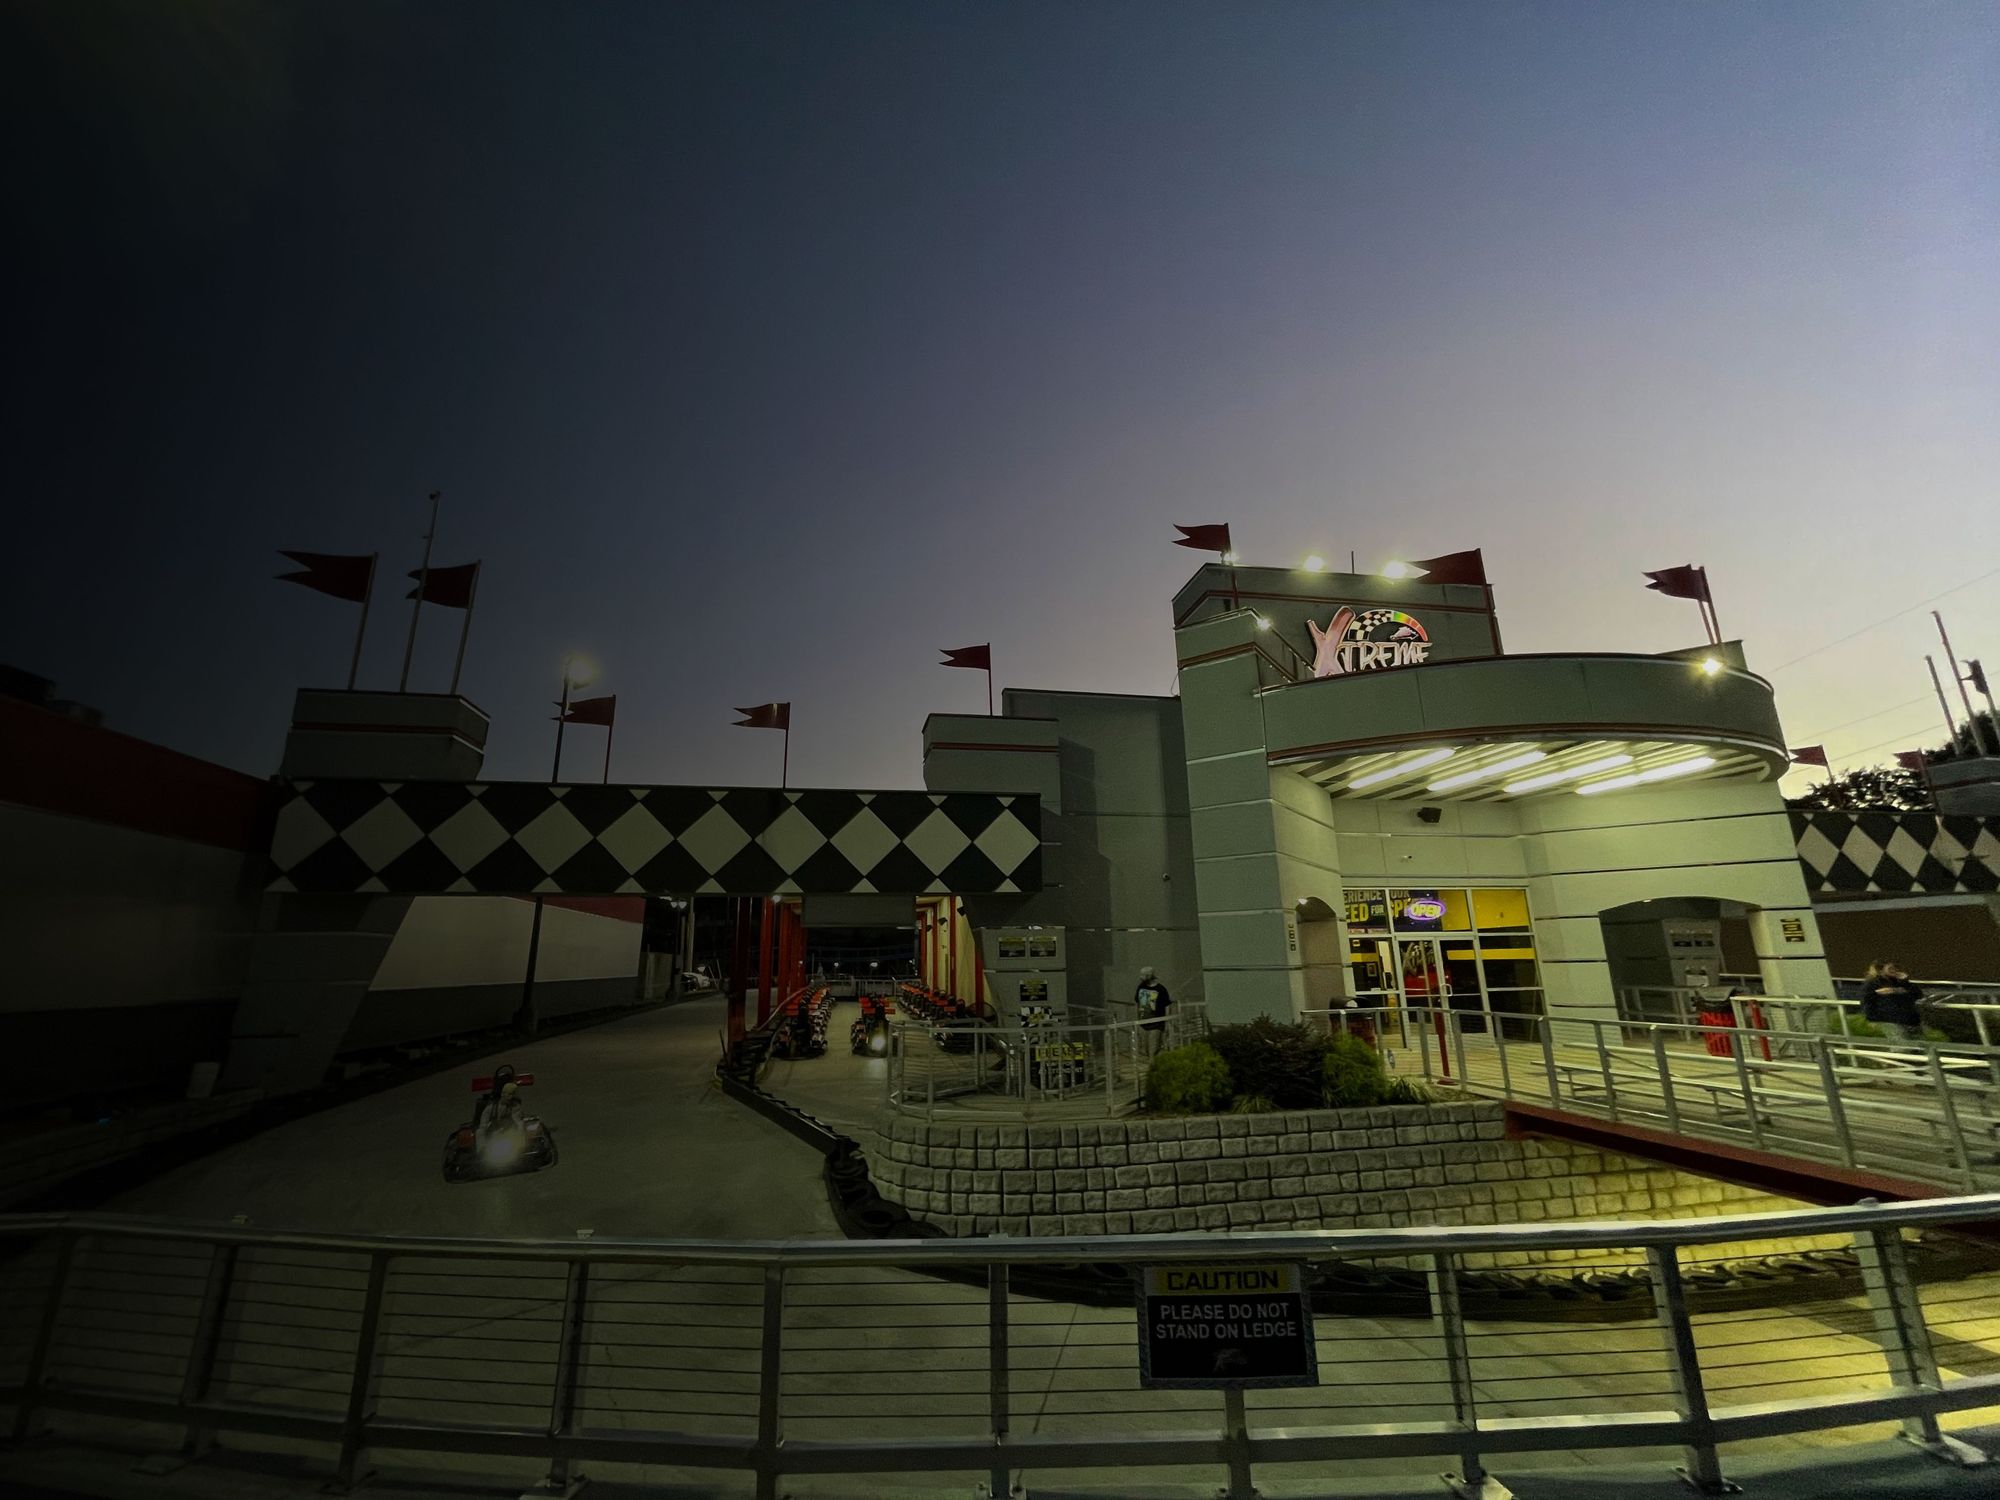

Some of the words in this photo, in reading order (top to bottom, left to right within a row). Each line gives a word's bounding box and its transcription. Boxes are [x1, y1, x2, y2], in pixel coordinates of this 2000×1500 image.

[1305, 605, 1433, 678] XTREME
[1410, 903, 1442, 919] OPEN
[1167, 1270, 1279, 1291] CAUTION
[1159, 1304, 1225, 1320] PLEASE
[1229, 1303, 1253, 1319] DO
[1257, 1302, 1290, 1318] NOT
[1155, 1322, 1210, 1340] STAND
[1214, 1322, 1239, 1339] ON
[1243, 1321, 1298, 1338] LEDGE
